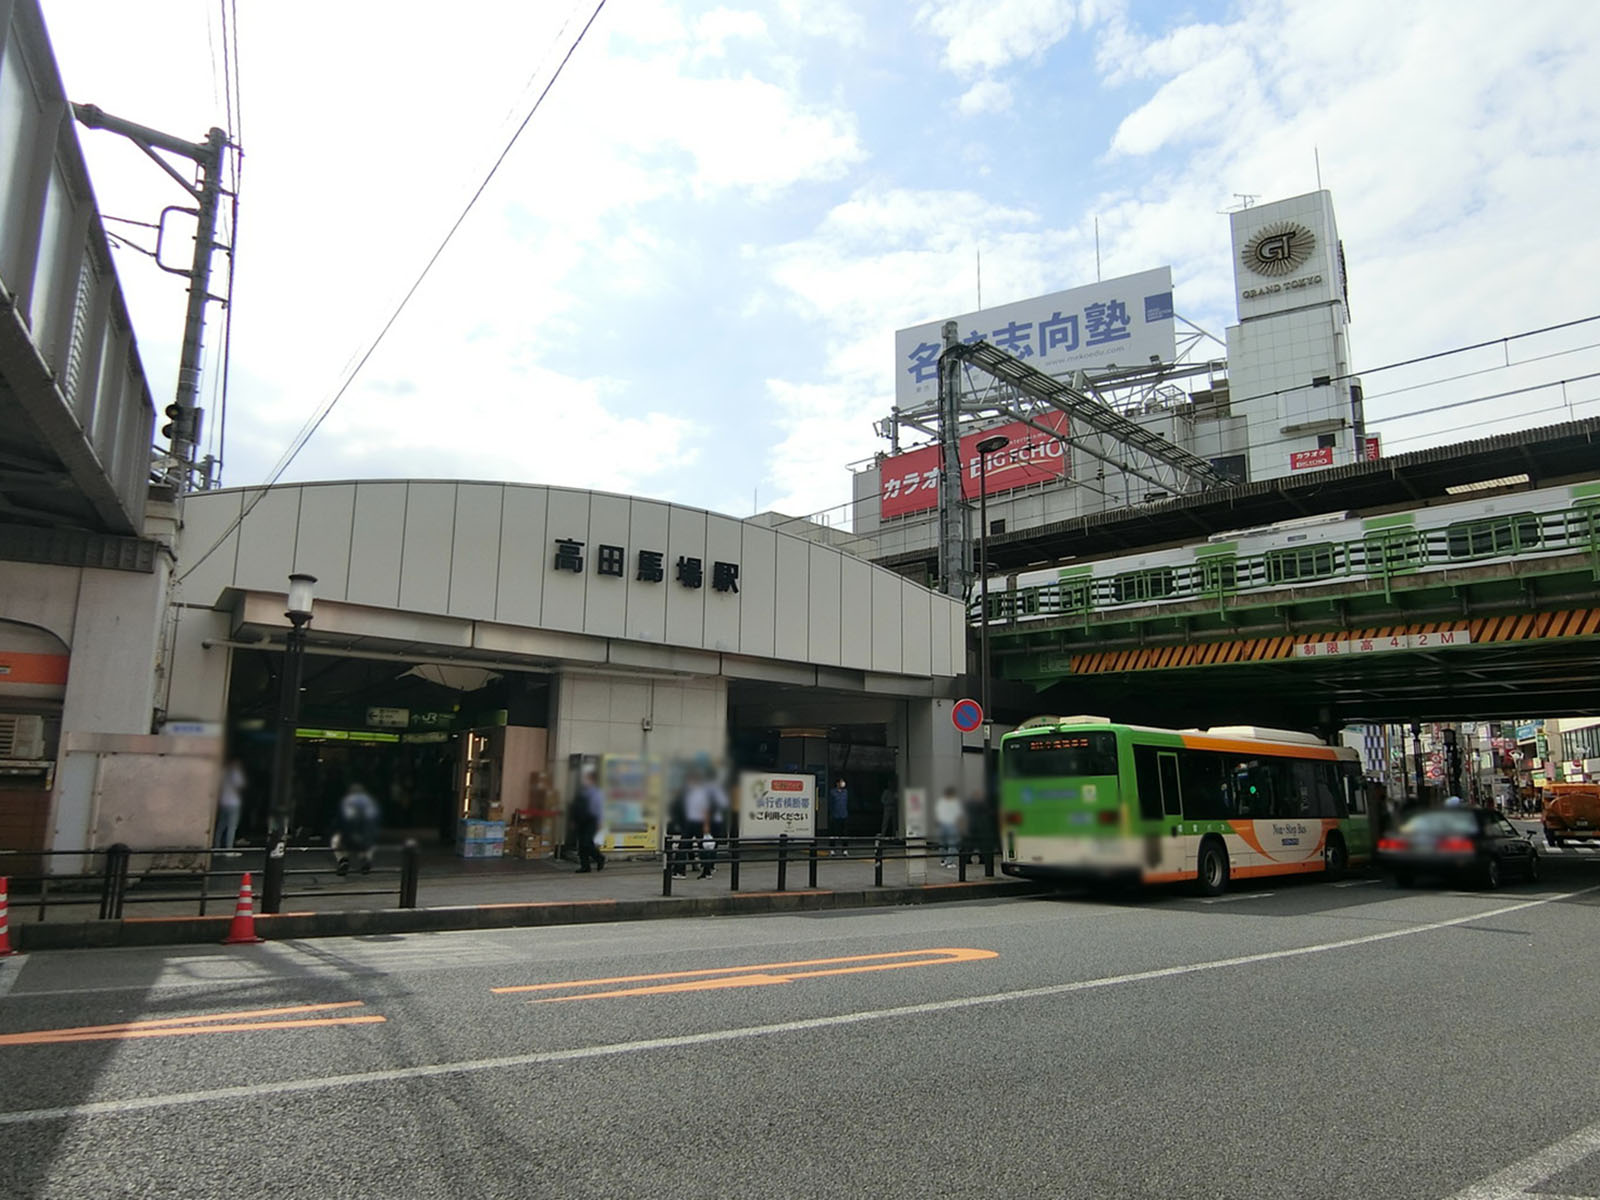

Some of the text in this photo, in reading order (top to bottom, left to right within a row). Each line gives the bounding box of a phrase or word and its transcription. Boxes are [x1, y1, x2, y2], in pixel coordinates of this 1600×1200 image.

[1242, 275, 1322, 299] GRAND TOKYO
[1296, 449, 1327, 460] カラオケ
[884, 438, 1068, 501] カラオ BIG ECHO
[554, 538, 739, 594] 高田馬場駅
[422, 712, 438, 721] JR
